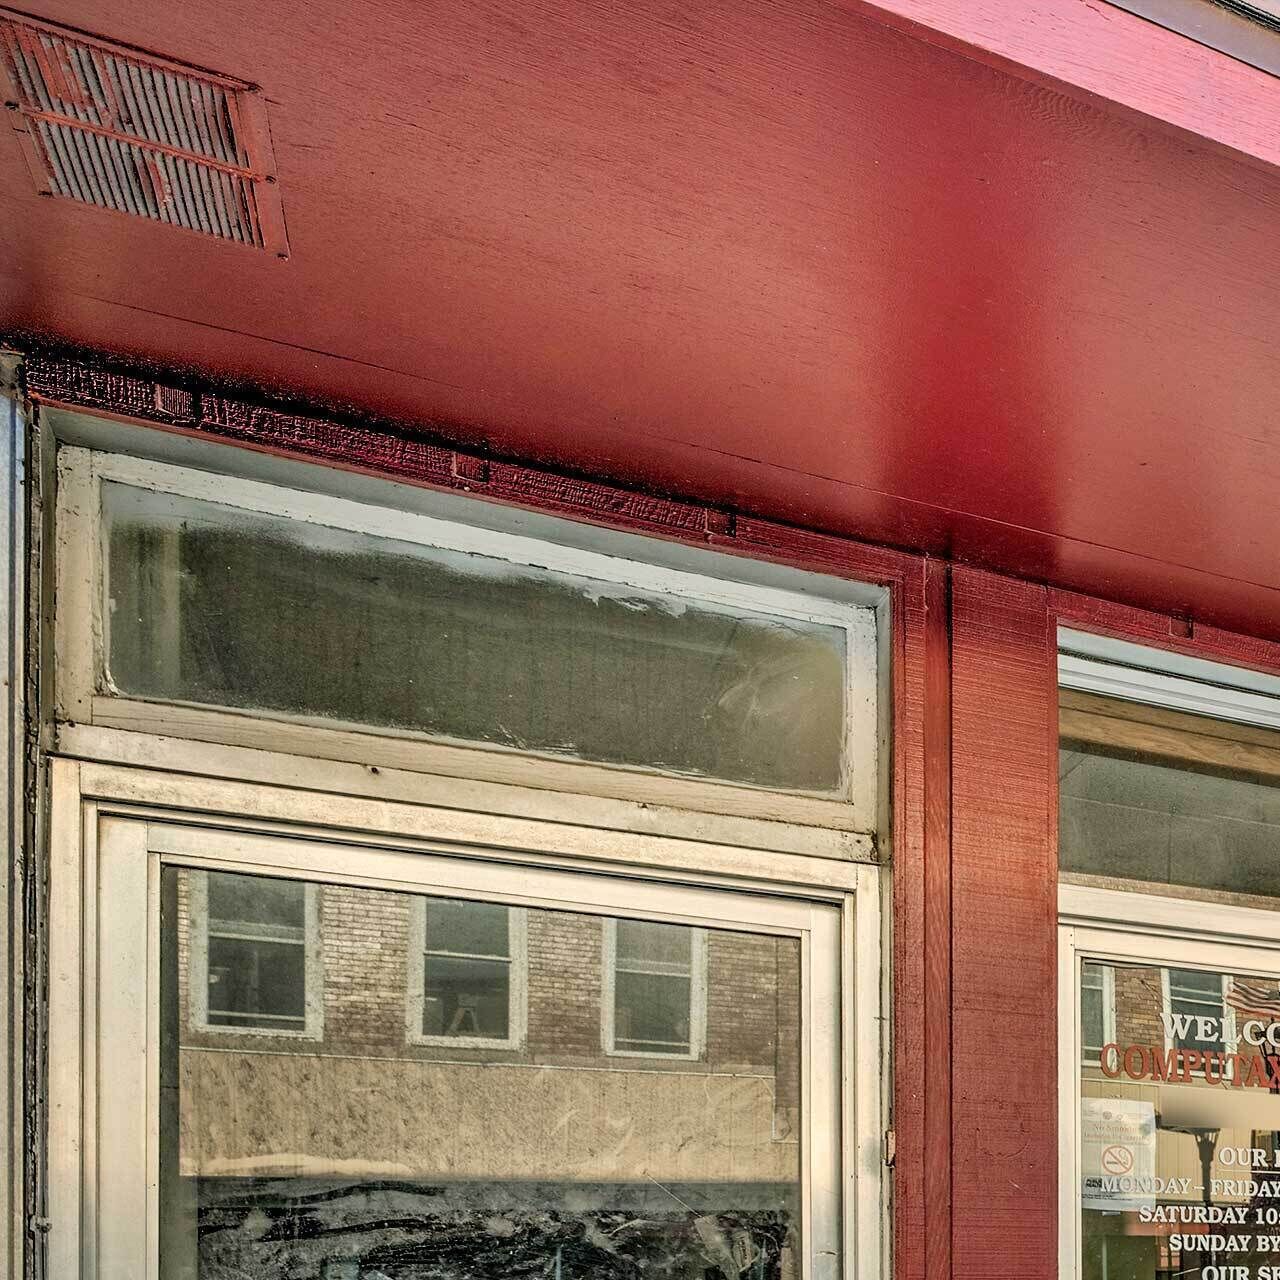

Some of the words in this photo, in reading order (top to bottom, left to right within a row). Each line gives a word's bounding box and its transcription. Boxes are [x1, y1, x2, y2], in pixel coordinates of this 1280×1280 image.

[1219, 1147, 1268, 1168] OUR
[1100, 1175, 1192, 1194] MONDAY
[1139, 1205, 1249, 1224] SATURDAY
[1169, 1234, 1251, 1251] SUNDAY
[1255, 1235, 1280, 1252] BY
